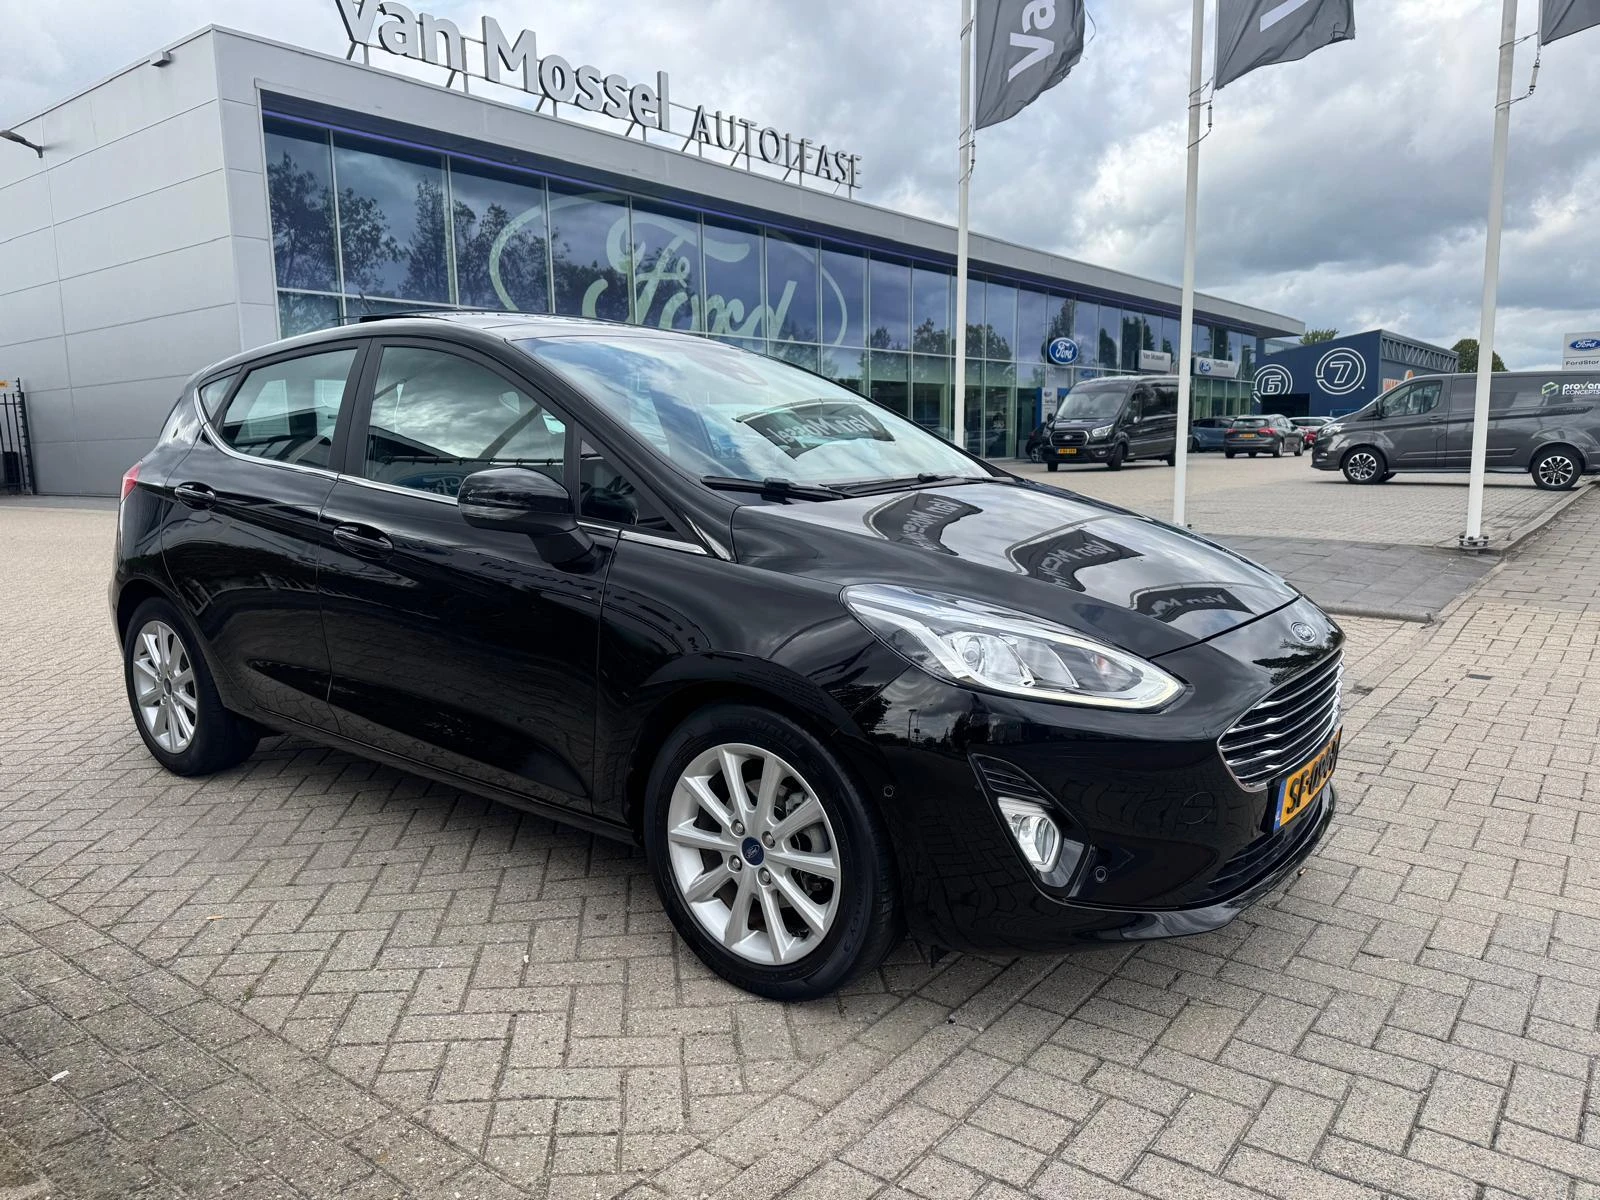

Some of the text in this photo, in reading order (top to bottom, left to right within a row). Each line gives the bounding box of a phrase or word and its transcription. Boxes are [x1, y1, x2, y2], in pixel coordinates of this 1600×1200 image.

[335, 0, 863, 189] Van Mossel AUTOLEASE
